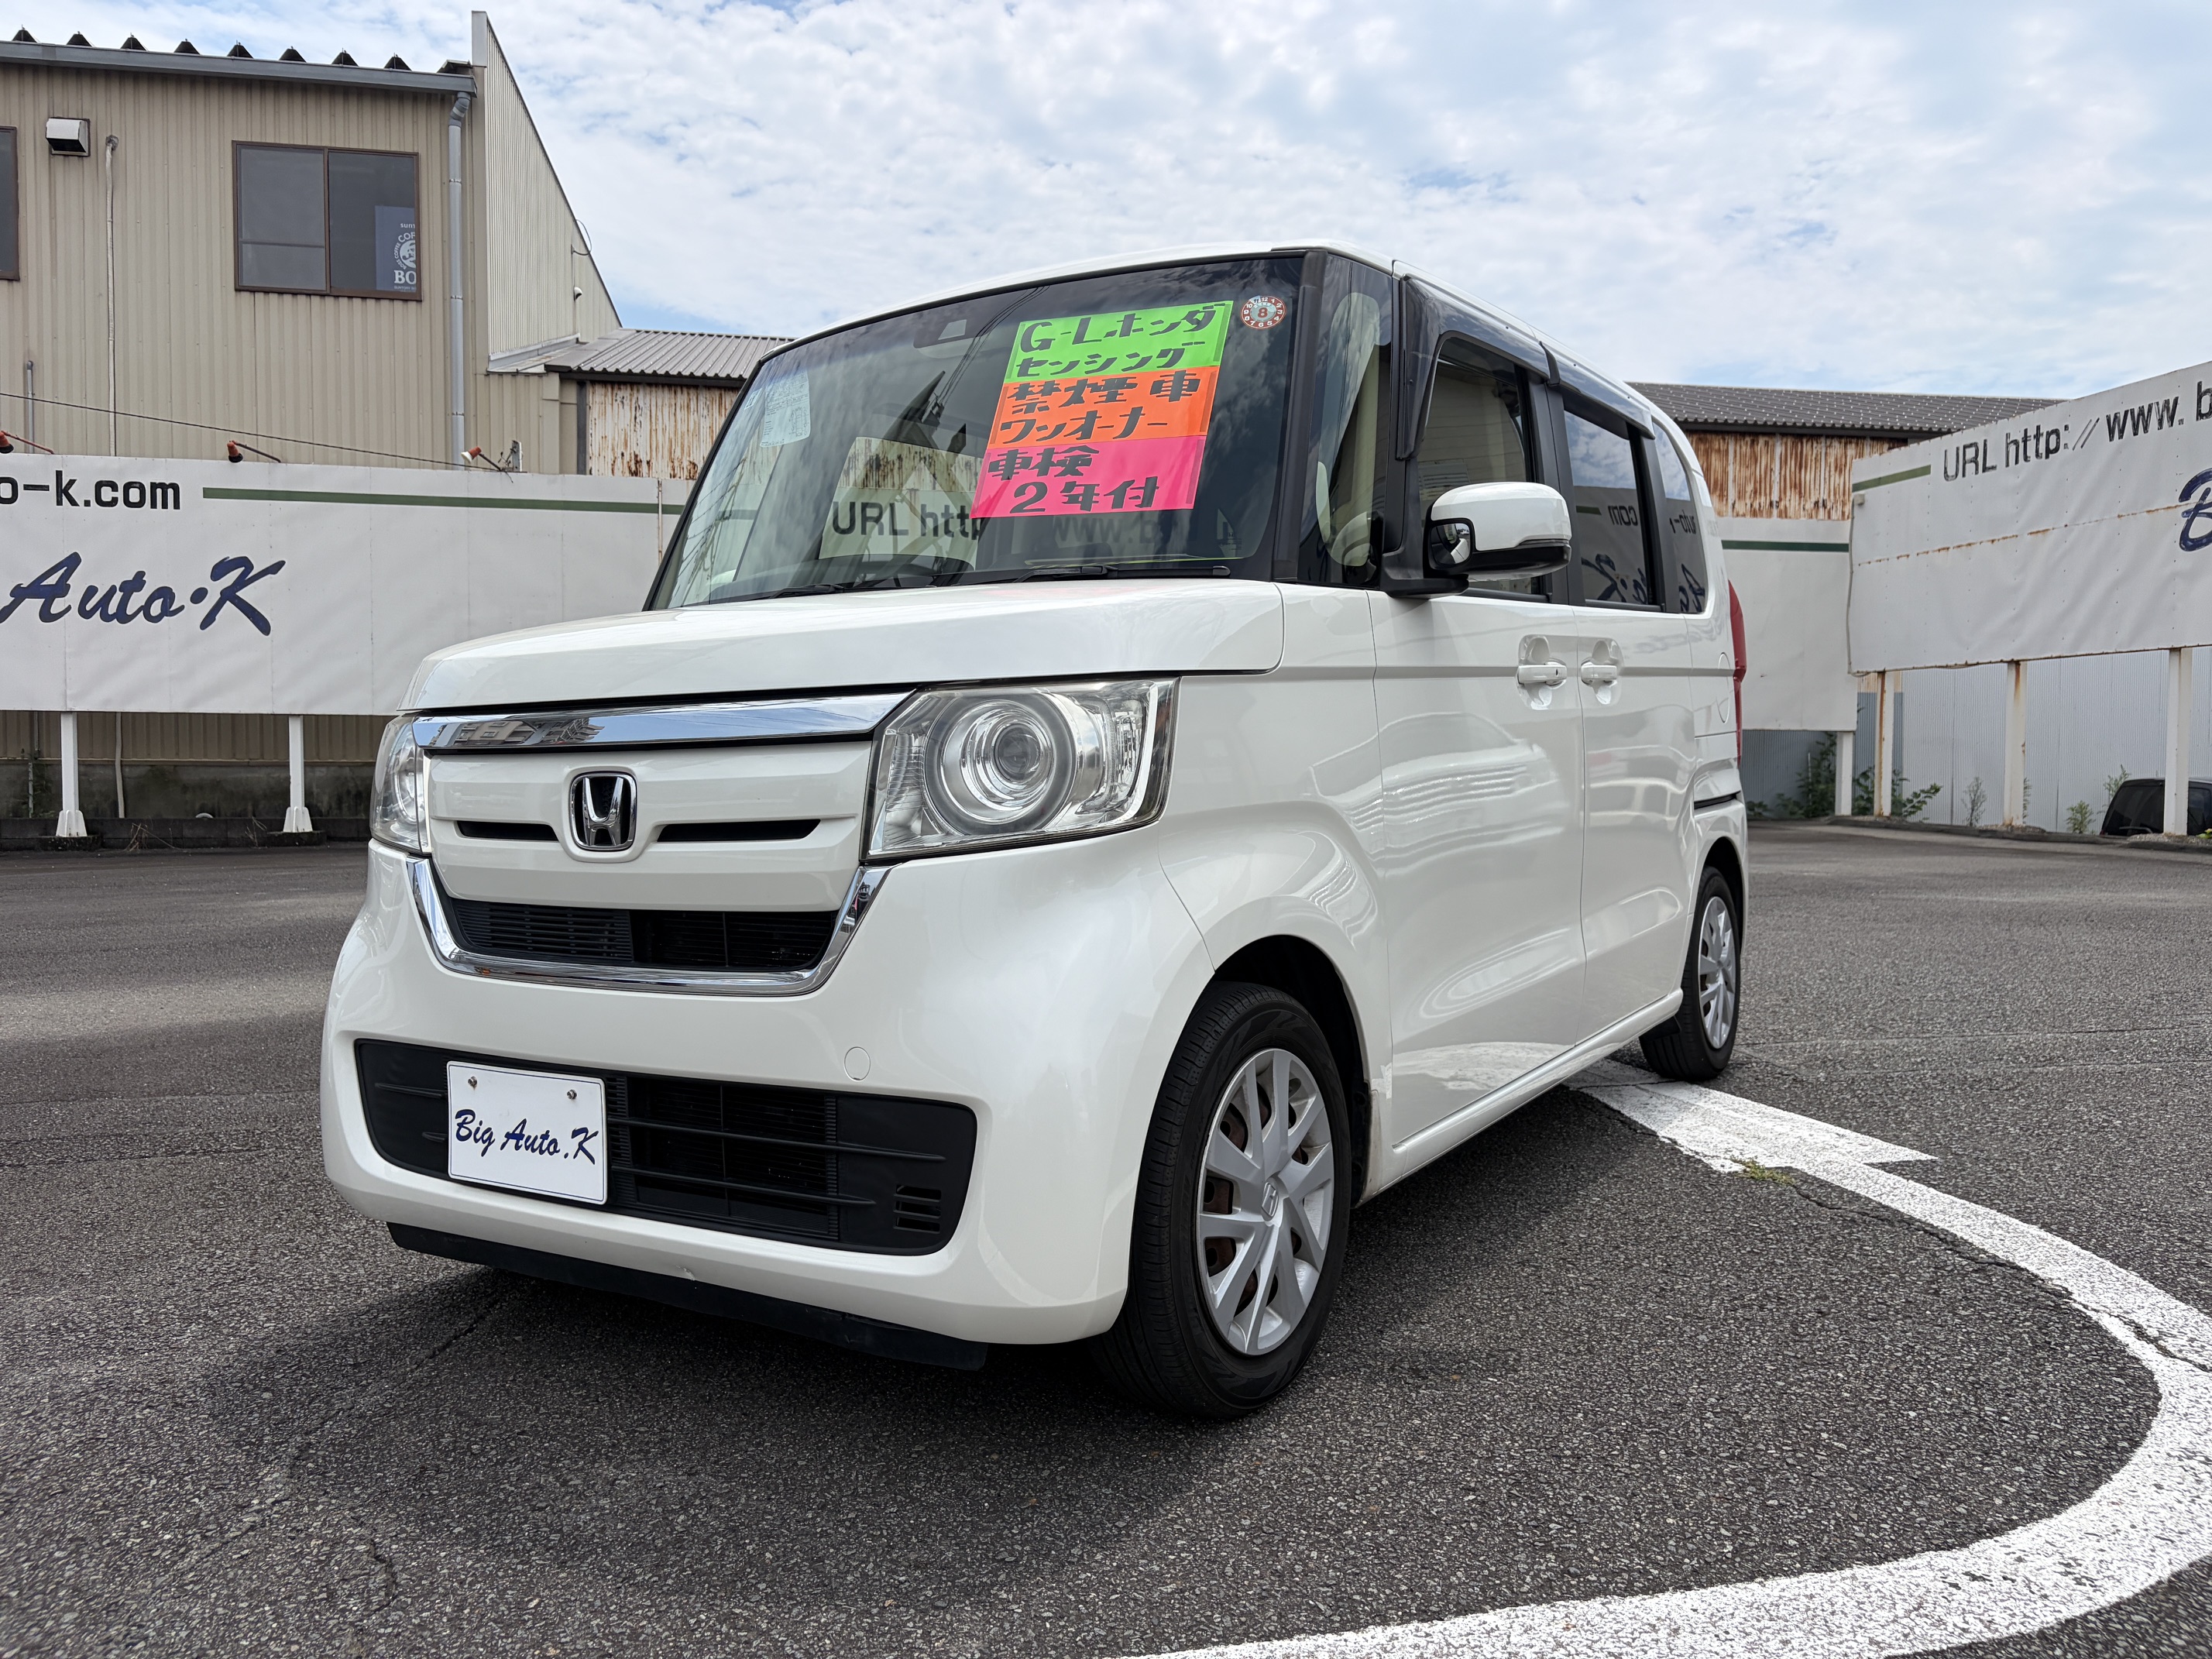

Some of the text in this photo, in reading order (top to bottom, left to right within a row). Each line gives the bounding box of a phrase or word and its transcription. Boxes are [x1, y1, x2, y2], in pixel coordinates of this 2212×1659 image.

[1258, 307, 1268, 318] 8
[1016, 342, 1206, 378] センシング
[1000, 406, 1168, 445] ワンオーナー
[988, 445, 1100, 482] 車検
[1943, 438, 1997, 482] URL
[831, 501, 910, 537] URL
[455, 1108, 496, 1157] Big
